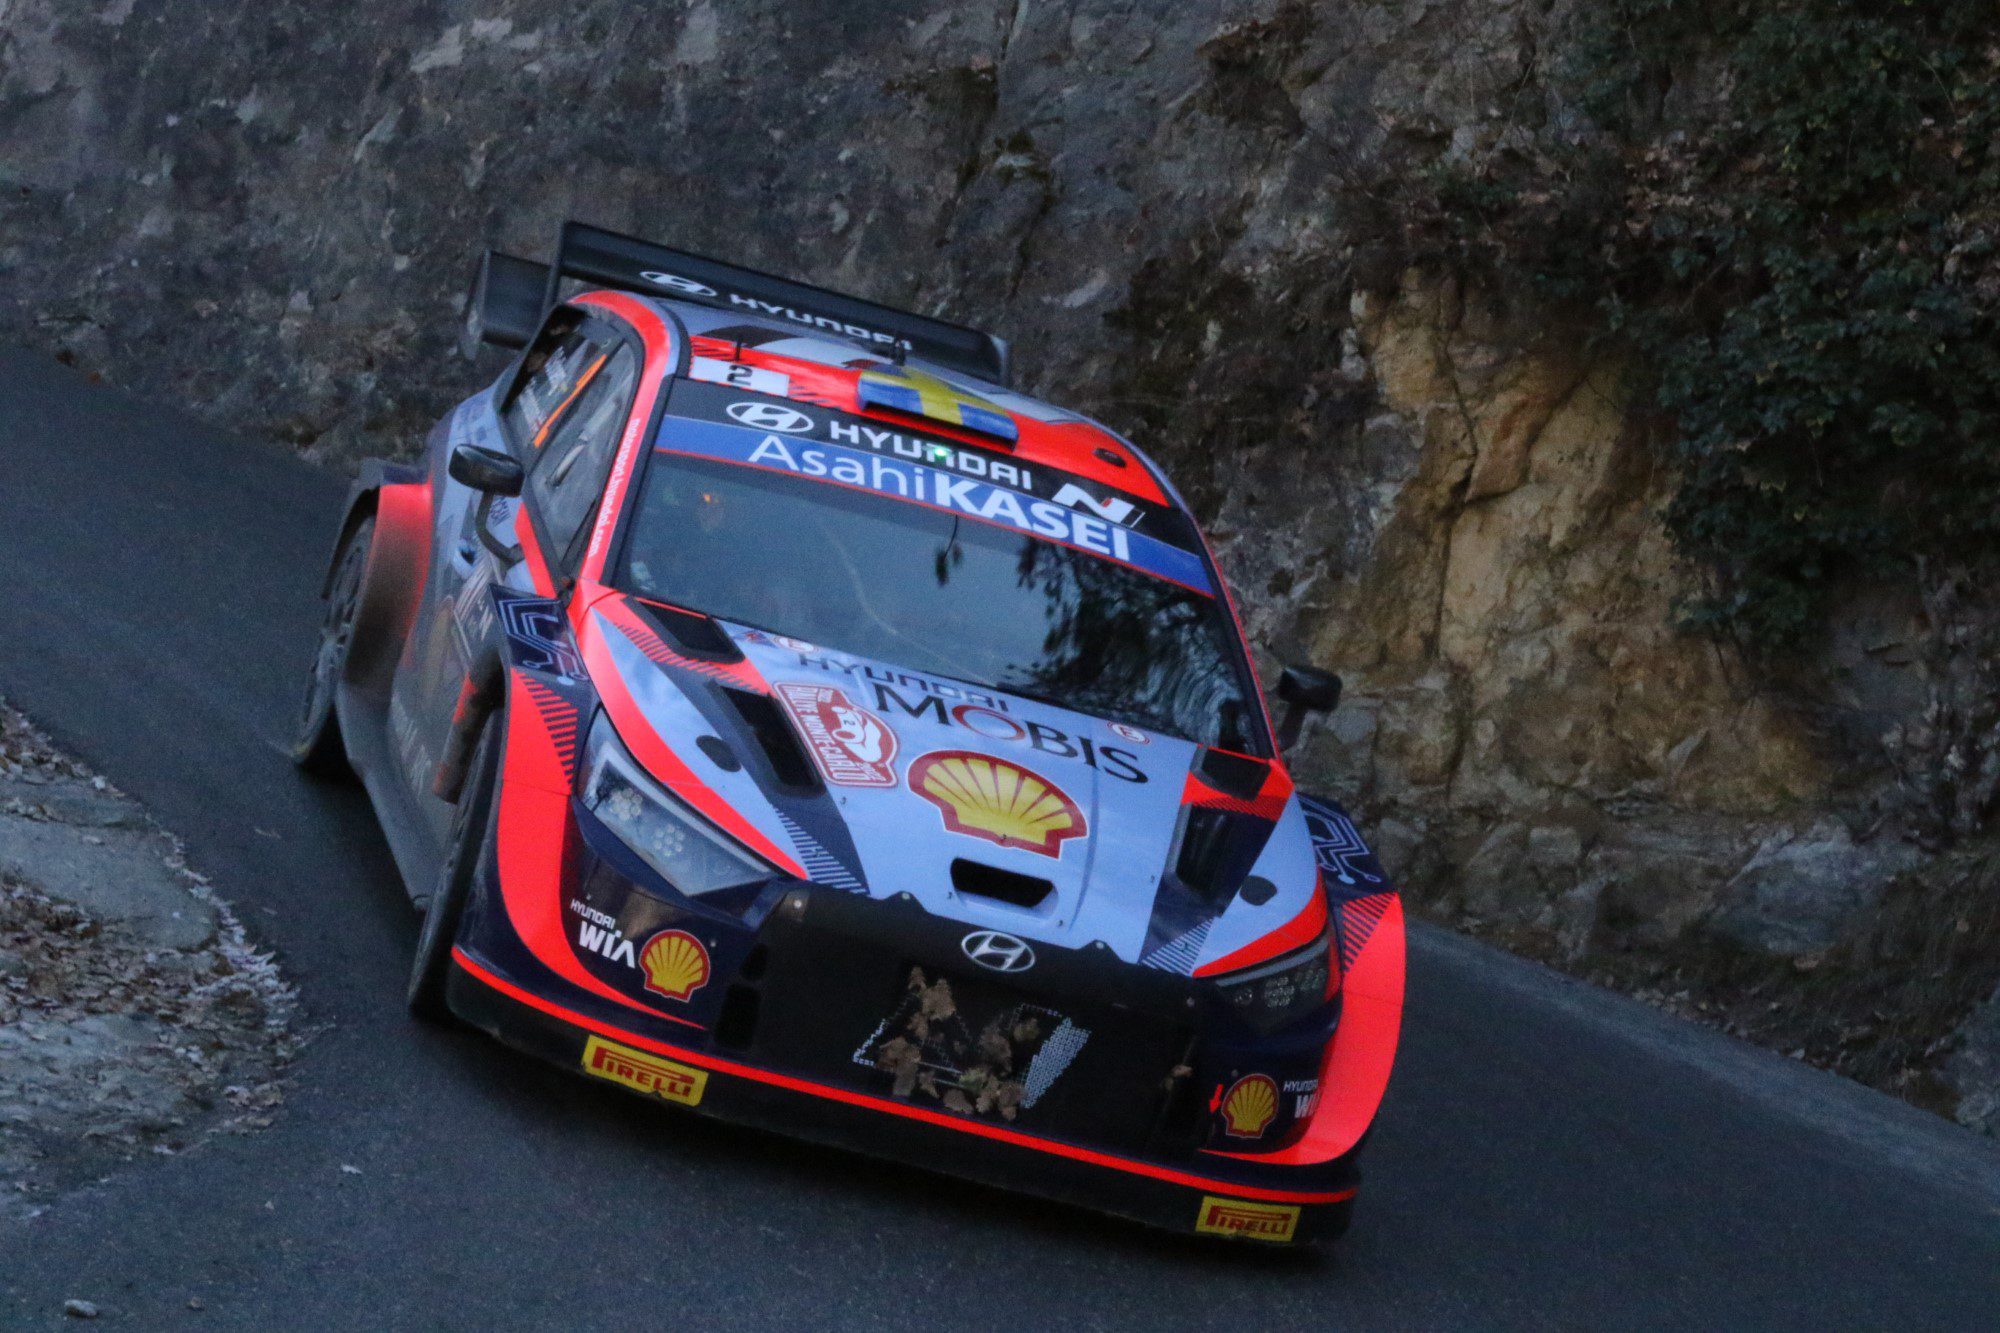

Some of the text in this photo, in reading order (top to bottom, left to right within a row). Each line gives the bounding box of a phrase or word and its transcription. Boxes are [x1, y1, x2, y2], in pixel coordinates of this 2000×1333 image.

[727, 364, 753, 385] 2
[829, 420, 1032, 490] HYUNDAI
[798, 652, 1009, 713] HYUNDAI
[872, 682, 1149, 784] MOBIS
[570, 899, 617, 930] HYUNDAI
[578, 920, 636, 969] WIA
[592, 1046, 697, 1098] PIRELLI
[1205, 1204, 1292, 1235] PIRELLI
